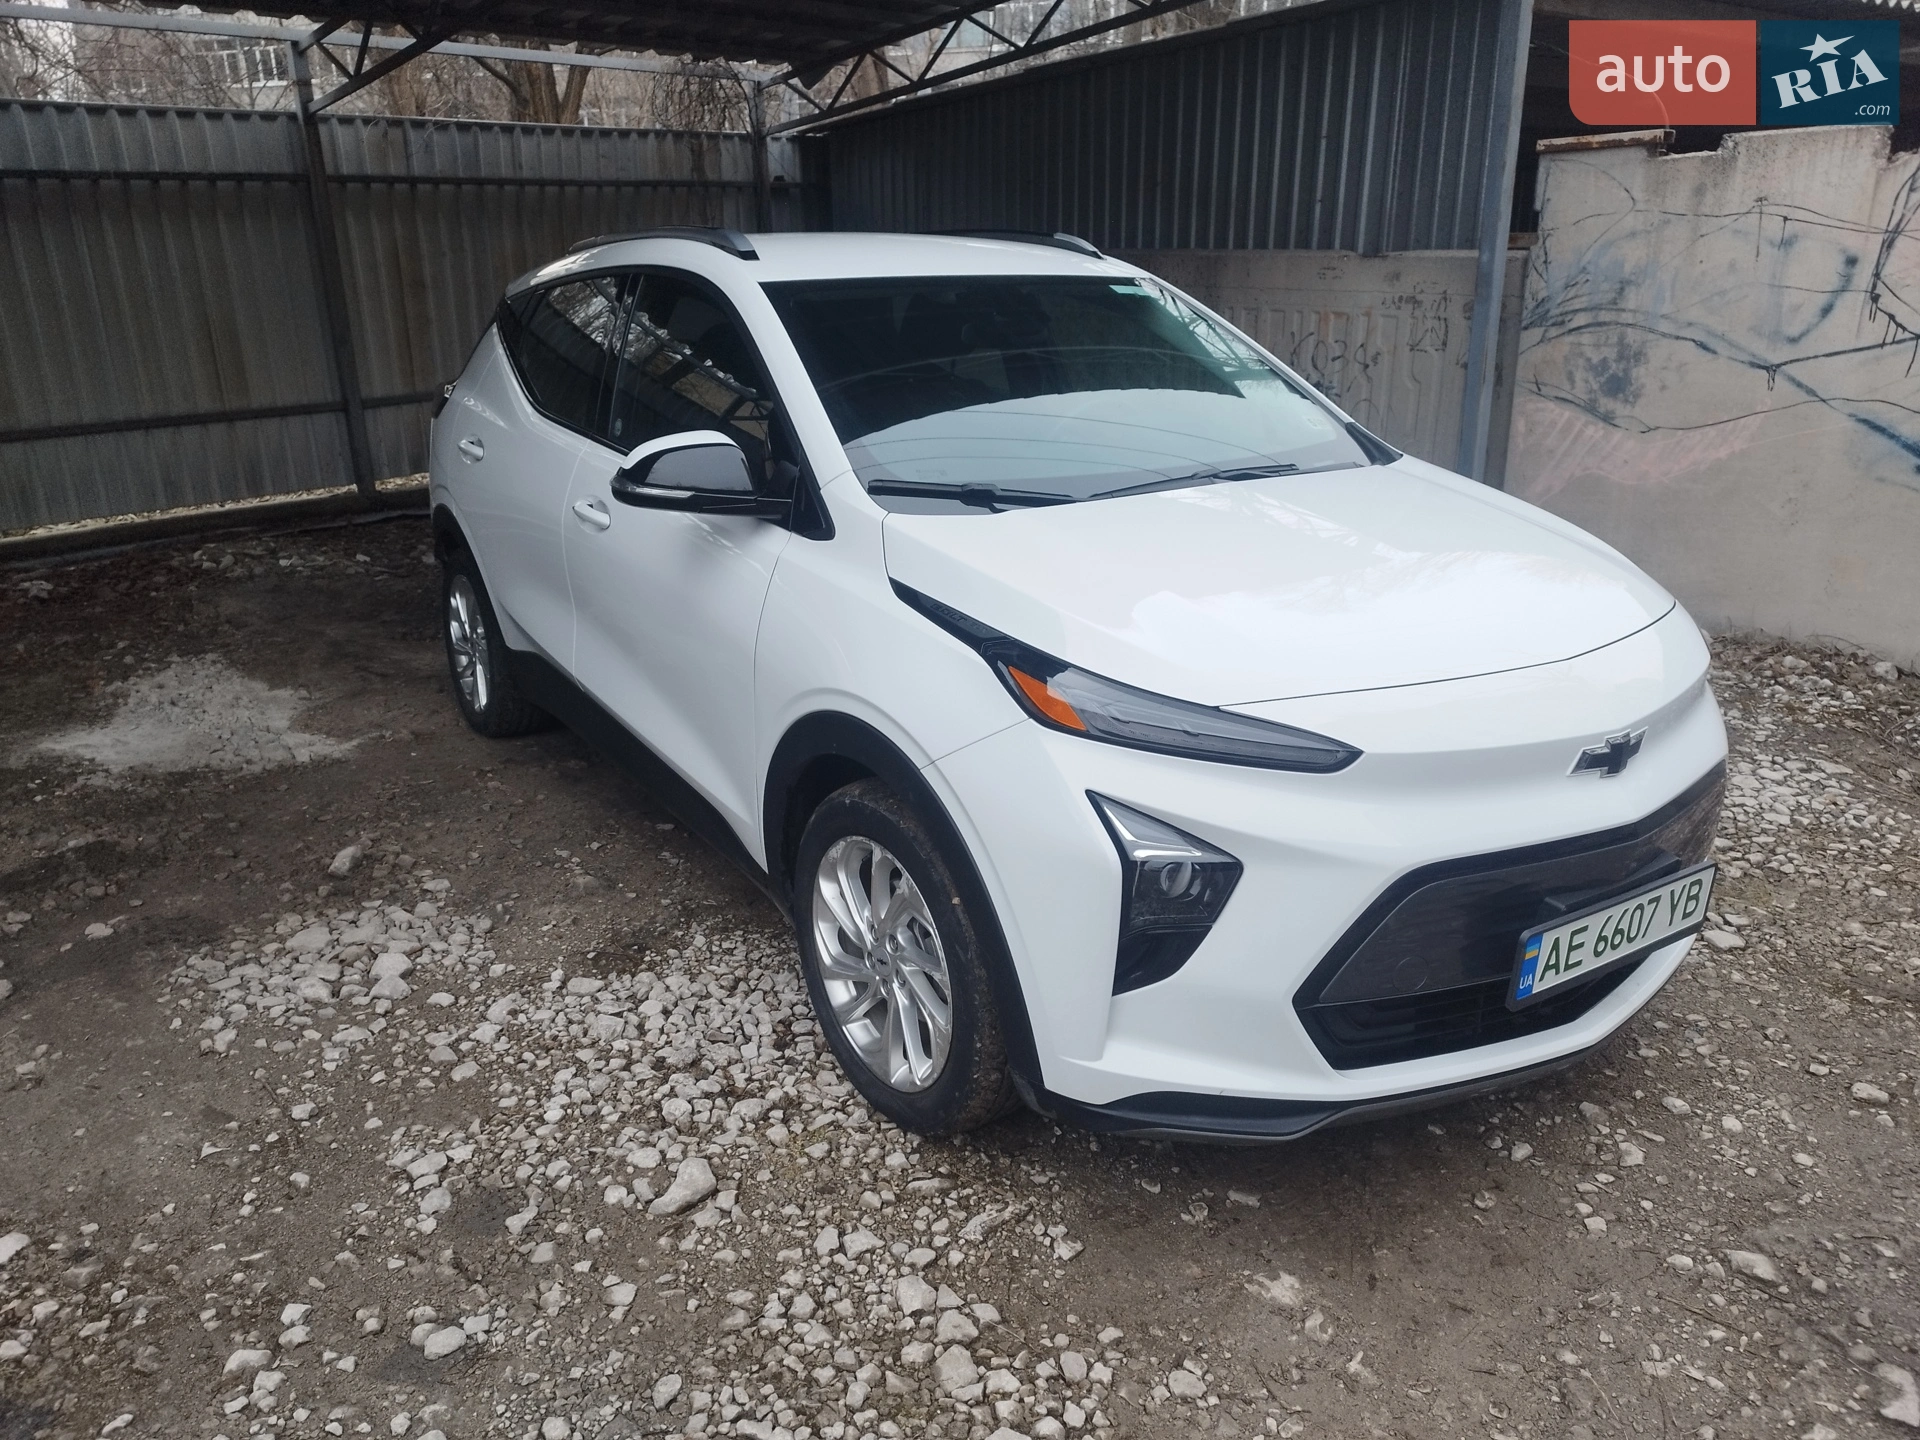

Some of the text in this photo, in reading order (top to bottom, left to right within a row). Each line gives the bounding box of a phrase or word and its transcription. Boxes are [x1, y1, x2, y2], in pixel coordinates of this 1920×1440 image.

[1538, 878, 1703, 983] AE 6607 YB
[1519, 972, 1534, 989] UA
